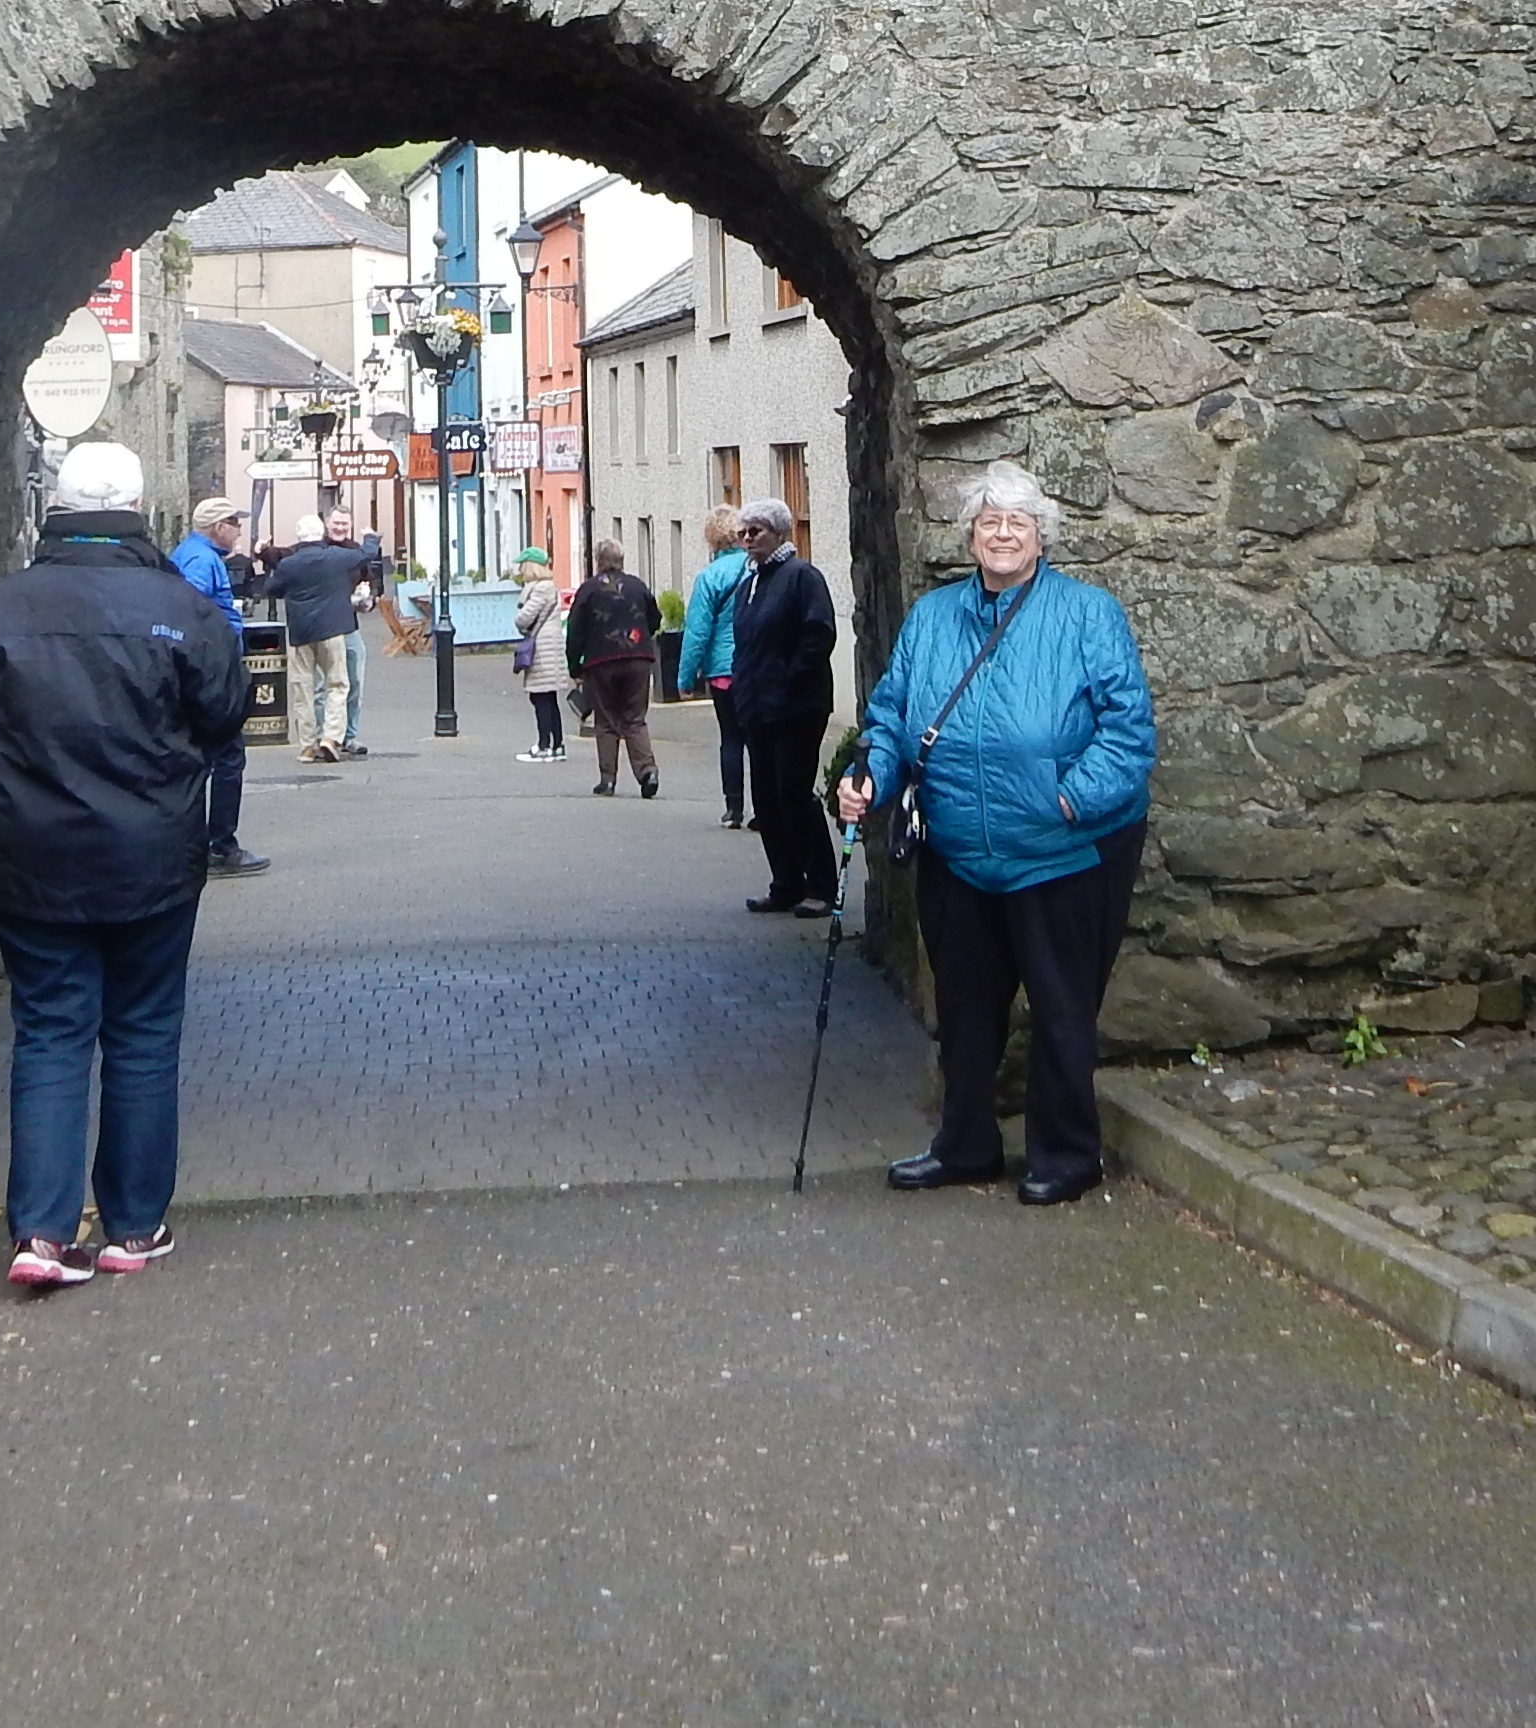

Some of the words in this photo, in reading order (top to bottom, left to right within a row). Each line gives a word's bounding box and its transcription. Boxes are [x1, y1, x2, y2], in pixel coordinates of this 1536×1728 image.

[333, 453, 363, 466] Sweet
[364, 453, 390, 466] Shop
[345, 465, 359, 476] Ice
[359, 465, 387, 476] Cream
